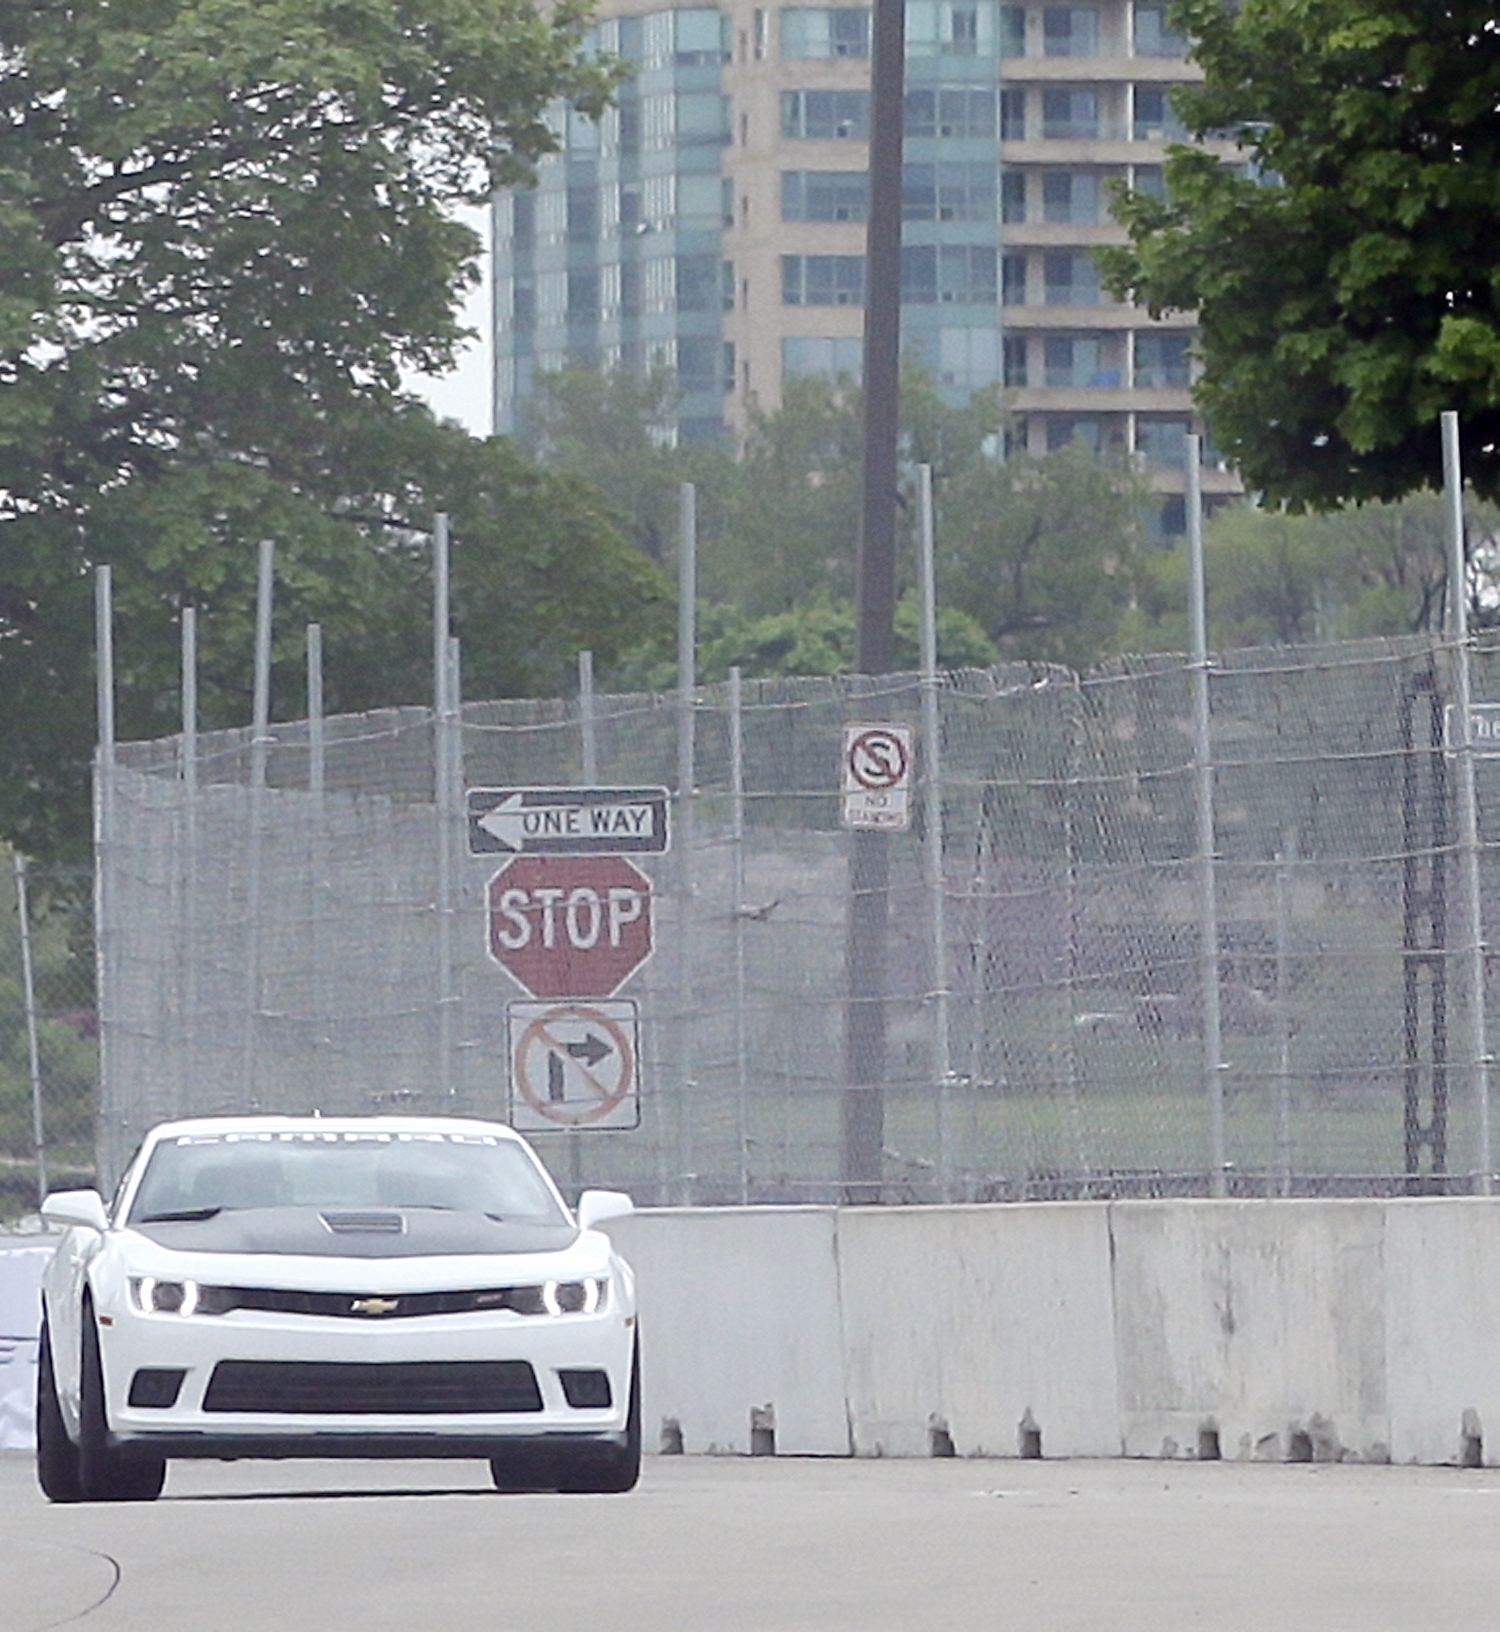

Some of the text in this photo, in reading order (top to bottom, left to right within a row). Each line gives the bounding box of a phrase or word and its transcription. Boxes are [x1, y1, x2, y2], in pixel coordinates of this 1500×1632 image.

[523, 807, 648, 834] ONE WAY
[498, 886, 642, 950] STOP
